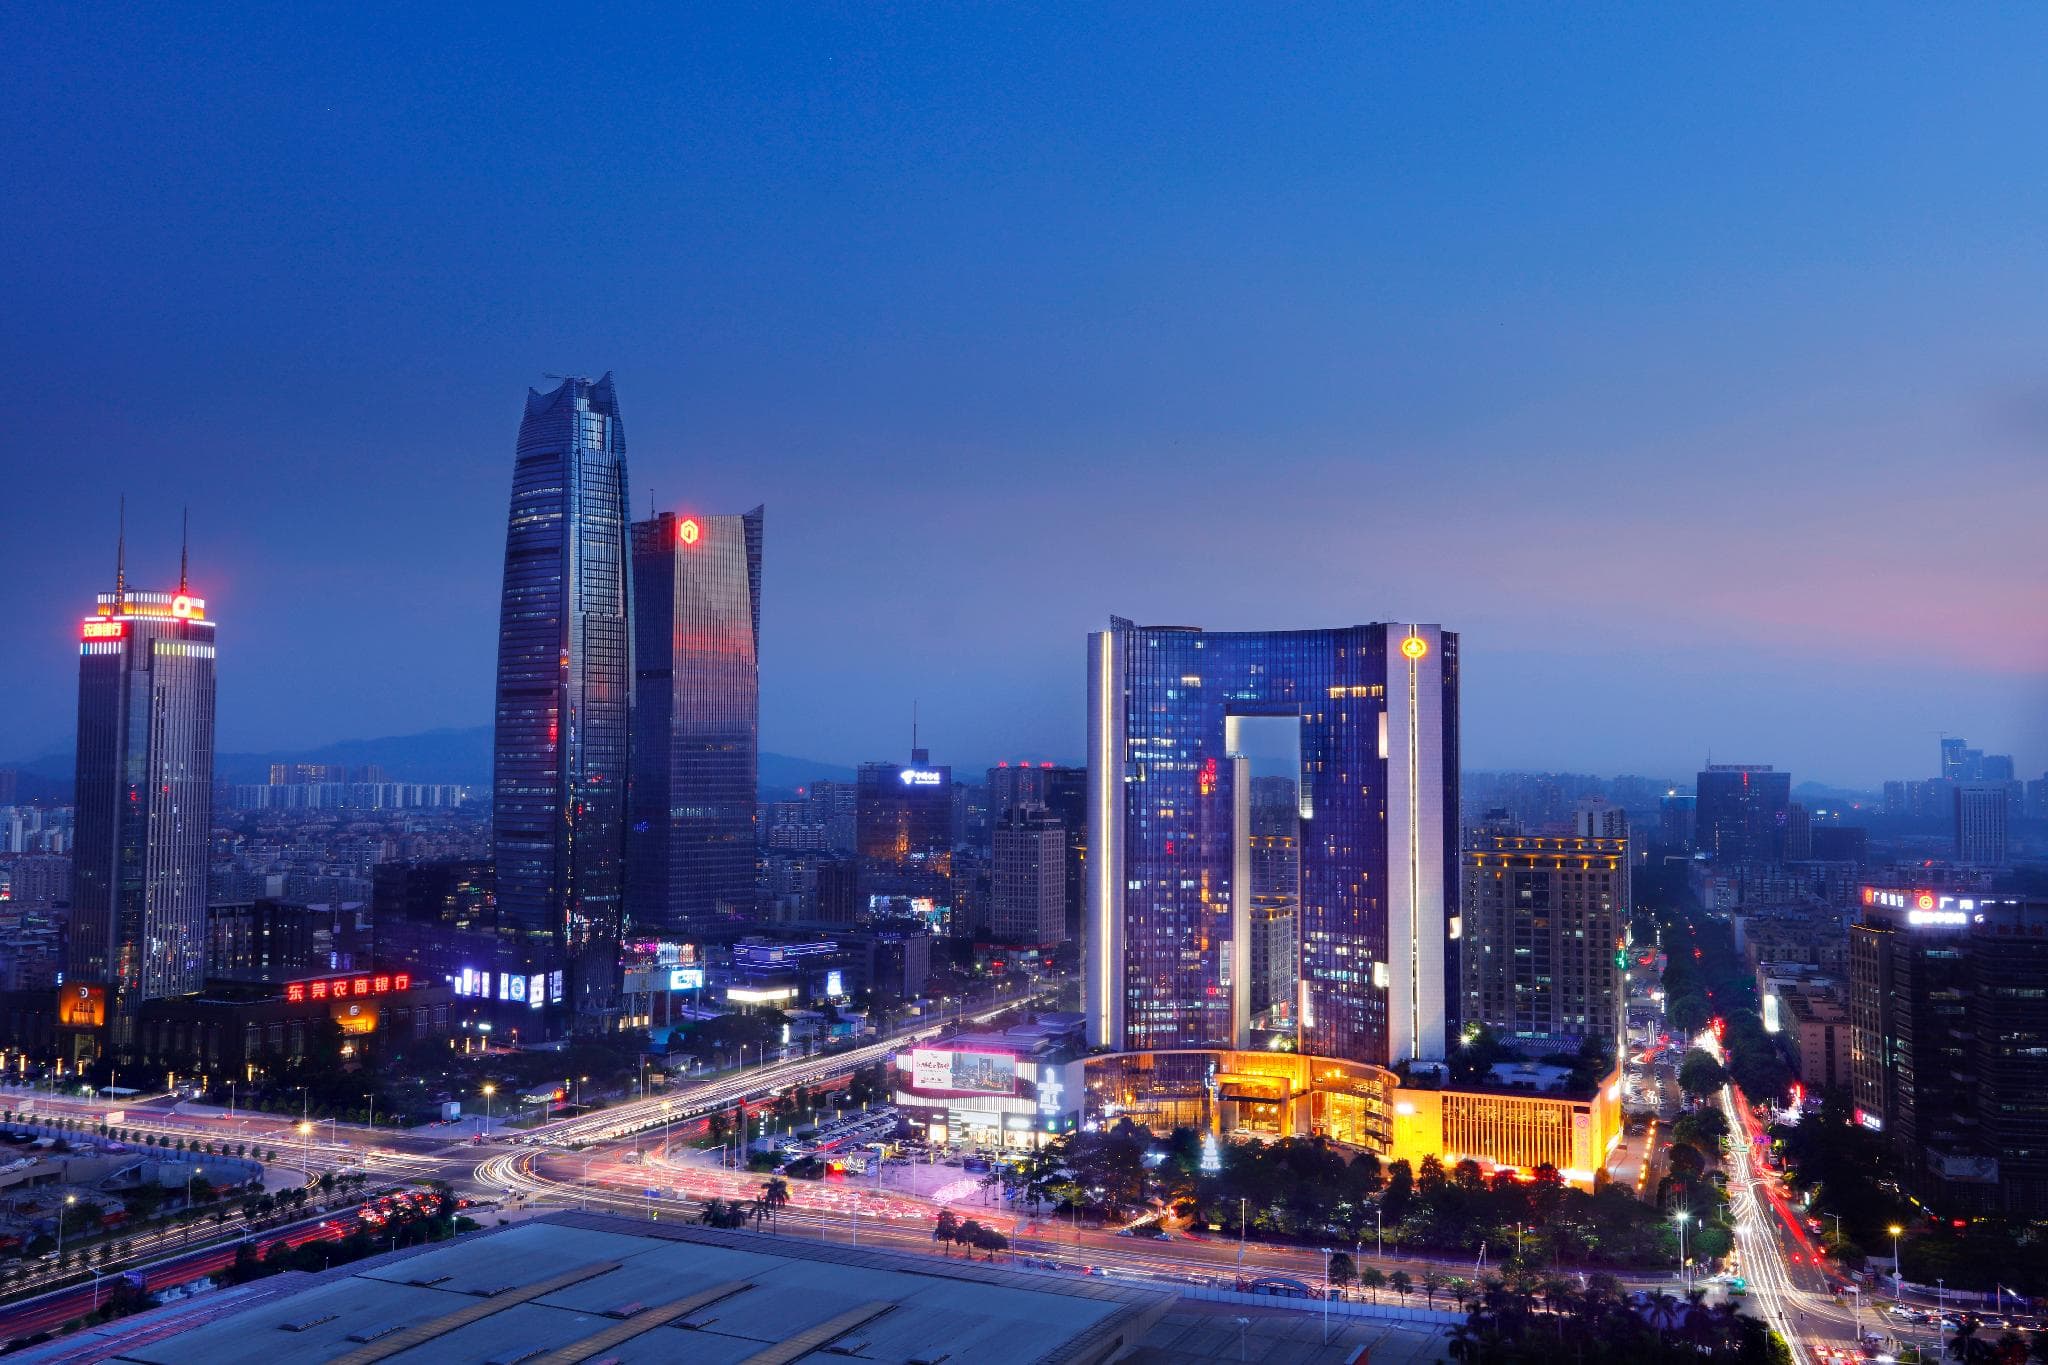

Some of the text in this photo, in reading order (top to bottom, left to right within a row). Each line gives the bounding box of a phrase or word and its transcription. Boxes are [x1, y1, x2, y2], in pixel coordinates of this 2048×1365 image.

[288, 975, 409, 1001] 东莞农商银行
